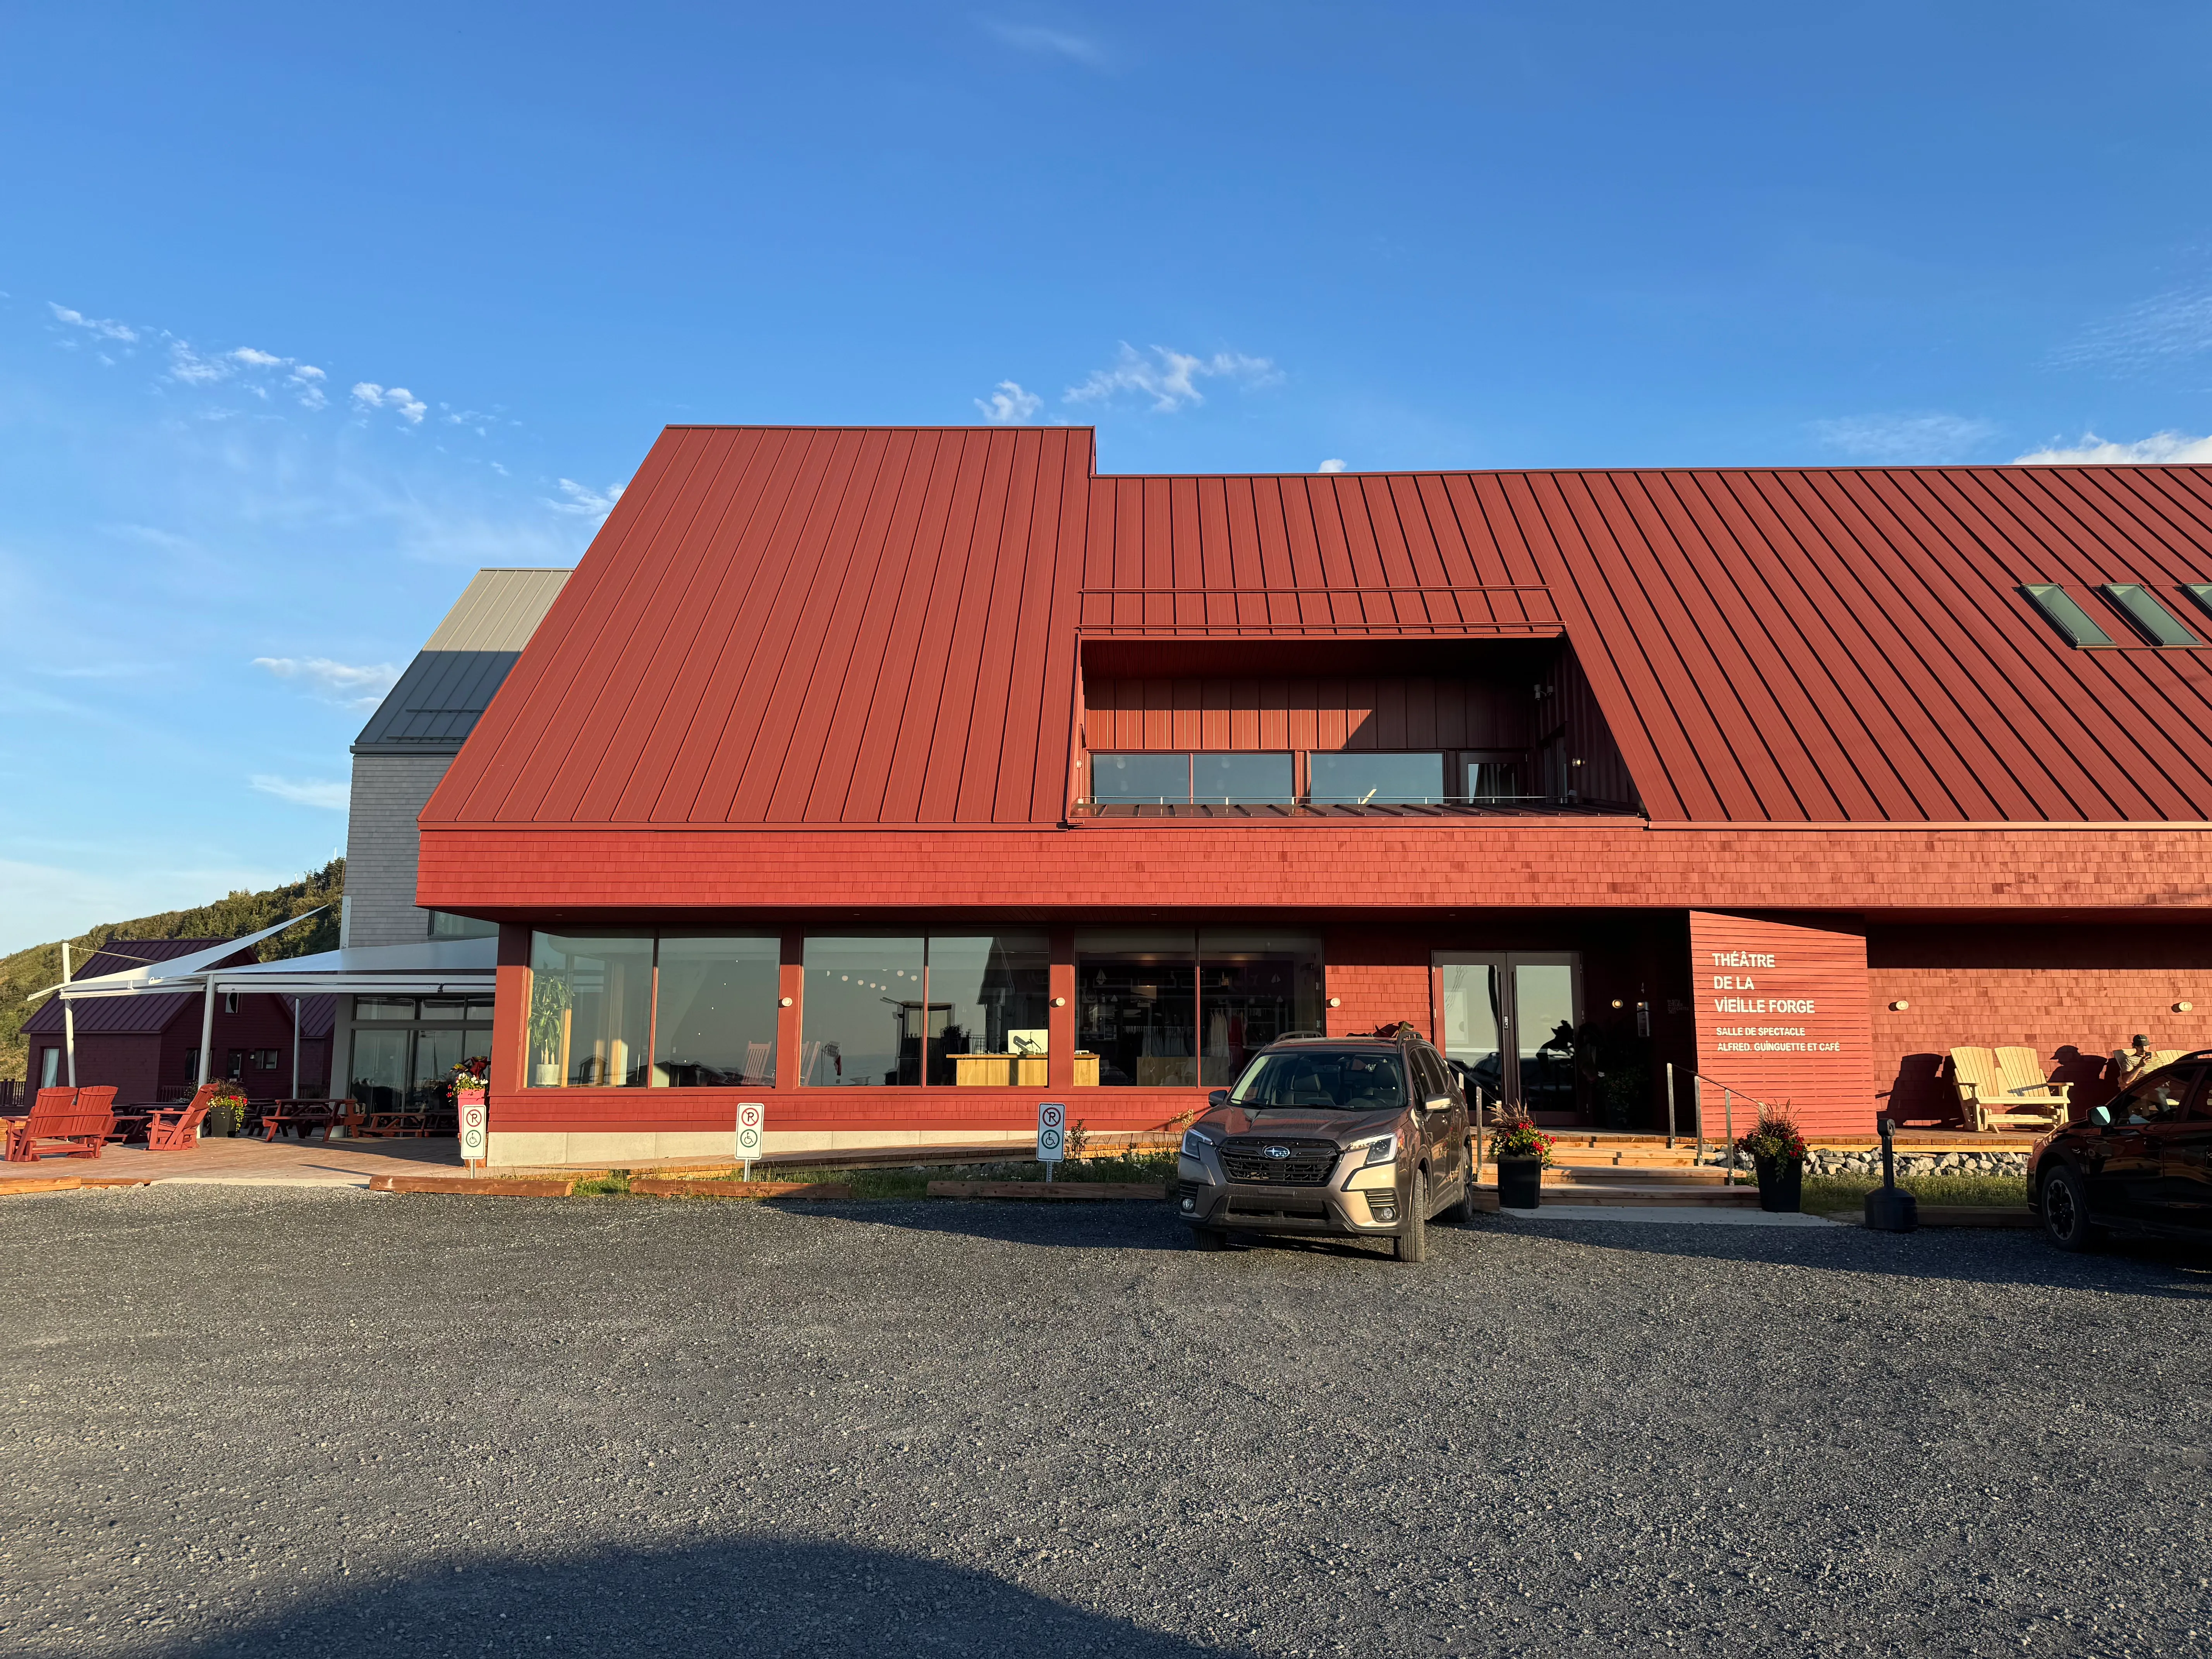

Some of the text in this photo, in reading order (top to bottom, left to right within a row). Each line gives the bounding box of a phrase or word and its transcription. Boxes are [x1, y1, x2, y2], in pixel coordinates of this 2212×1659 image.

[1712, 951, 1776, 967] THÉÂTRE
[1714, 975, 1755, 990] DE LA
[1769, 1000, 1815, 1013] FORGE
[1716, 1027, 1806, 1036] SALLE DE SPECTACLE
[1717, 1040, 1840, 1051] ALFRED. GUINGUETTE ET CAFÉ
